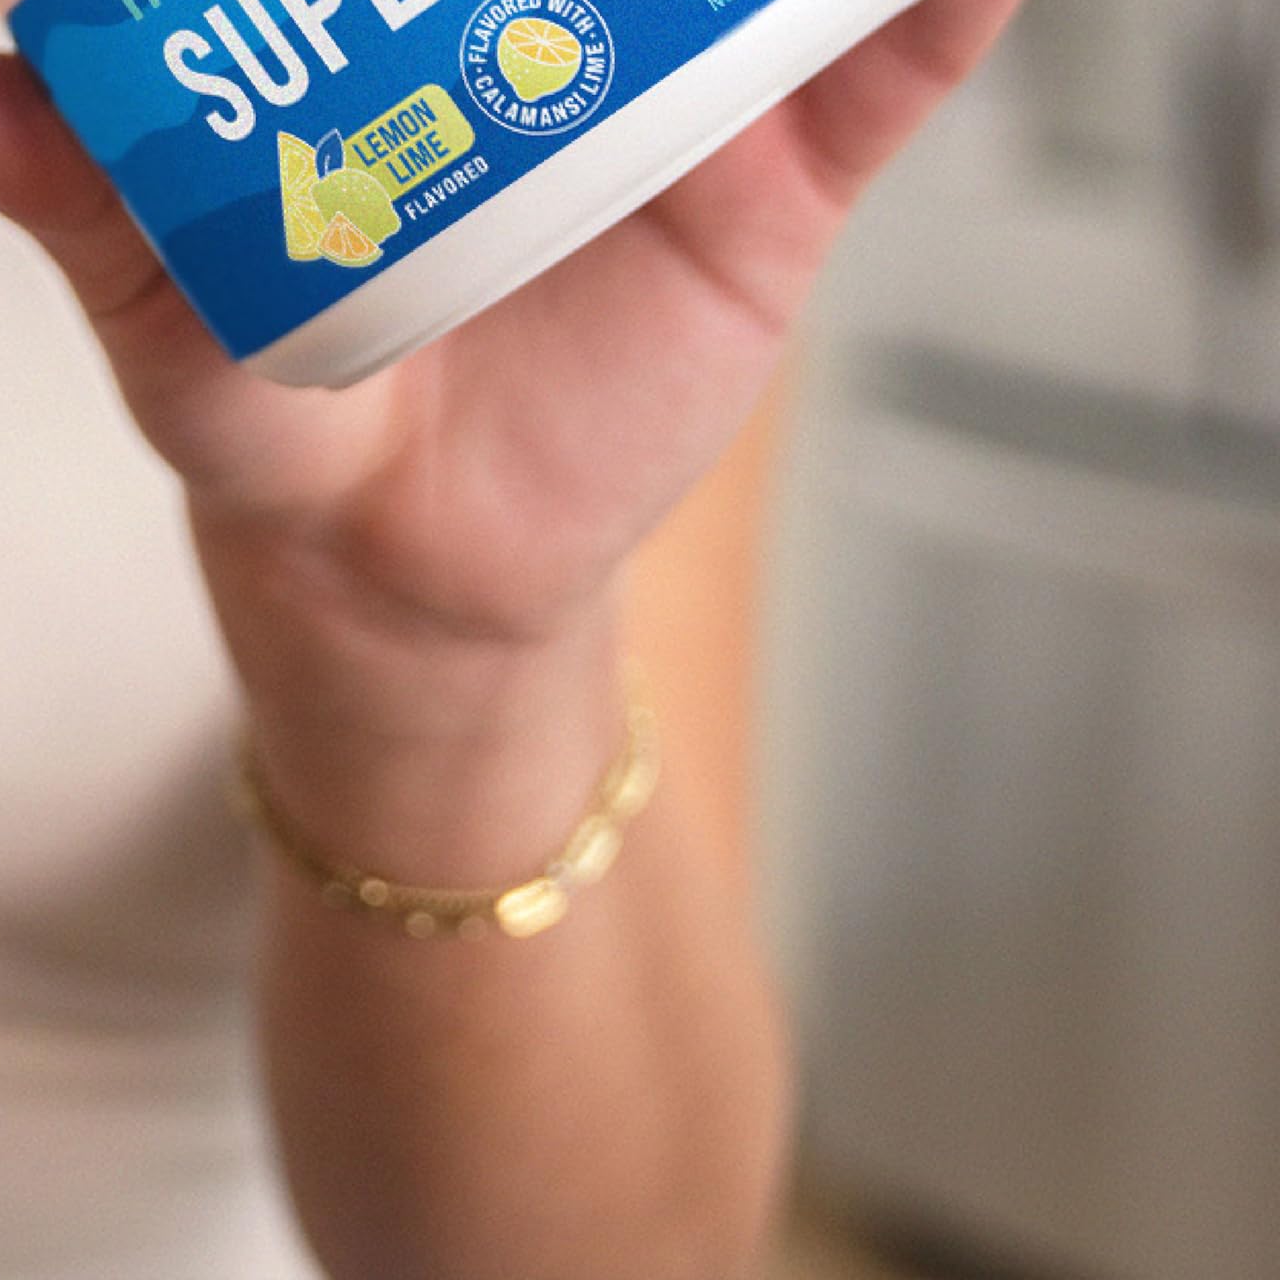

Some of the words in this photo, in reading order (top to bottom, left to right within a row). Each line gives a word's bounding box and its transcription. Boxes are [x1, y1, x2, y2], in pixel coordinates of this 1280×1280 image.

[475, 75, 587, 128] CALAMANSI
[580, 41, 606, 96] LIME
[352, 98, 437, 167] LEMON
[384, 131, 450, 184] LIME
[404, 155, 489, 220] FLAVORED
